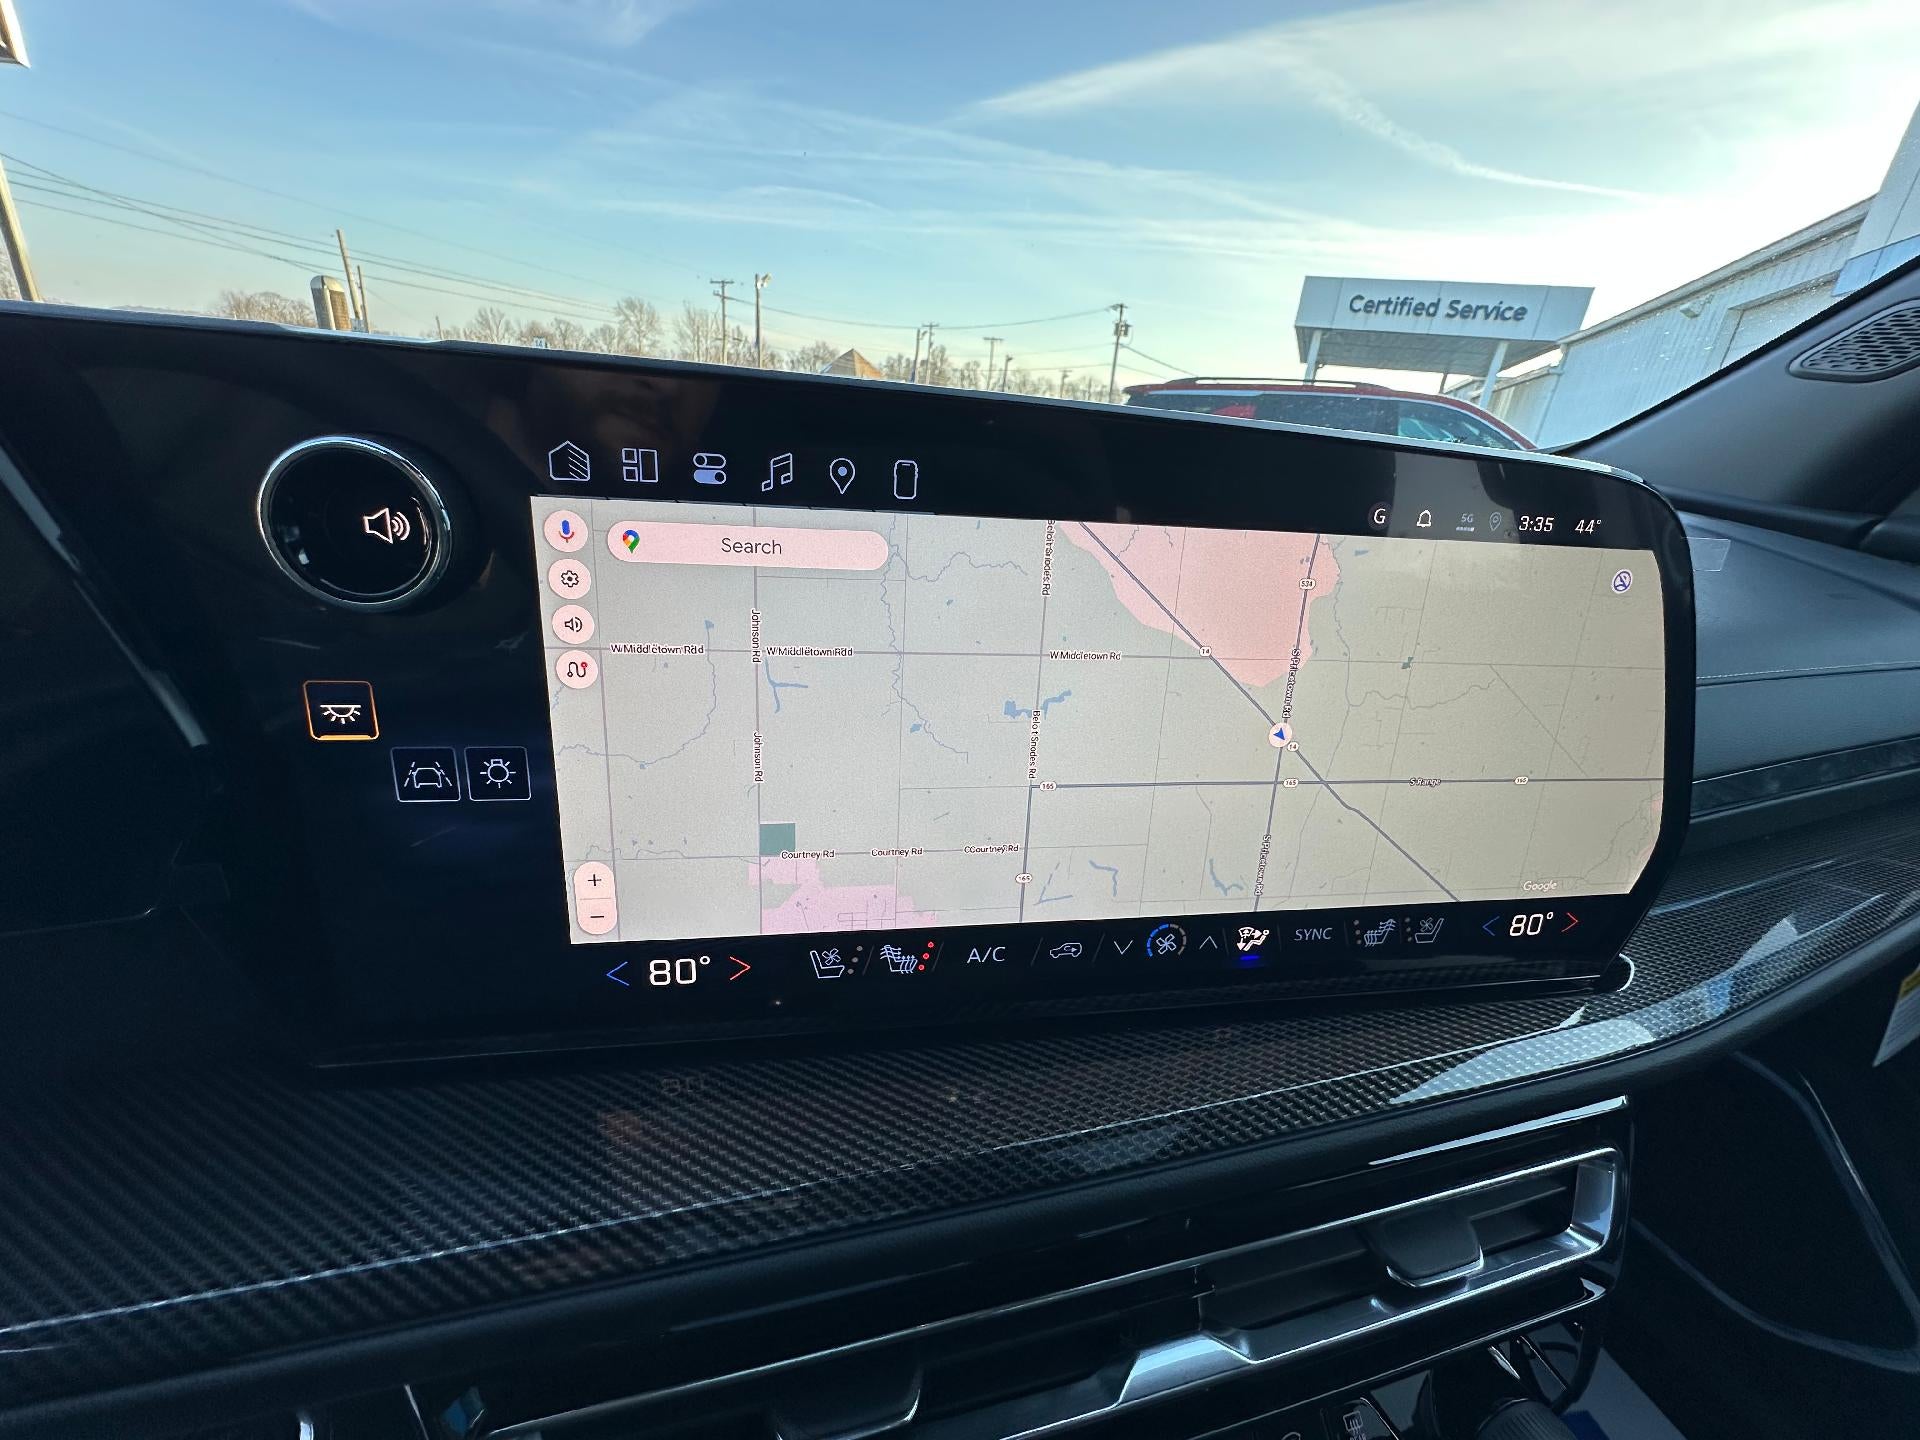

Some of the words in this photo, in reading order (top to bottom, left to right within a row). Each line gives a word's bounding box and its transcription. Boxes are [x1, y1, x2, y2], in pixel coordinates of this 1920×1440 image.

[1349, 294, 1440, 318] Certified
[1445, 299, 1528, 321] Service
[1460, 513, 1474, 524] 5G
[1518, 515, 1554, 532] 3:35
[1574, 519, 1602, 535] 44°
[721, 537, 782, 555] Search
[1041, 583, 1051, 596] Rd
[1301, 580, 1313, 588] 534
[751, 609, 761, 649] Johnson
[752, 650, 762, 663] Rd
[1050, 650, 1059, 660] W
[1110, 651, 1121, 660] Rd
[753, 732, 763, 769] Johnson
[1029, 736, 1039, 767] Snodes
[754, 770, 763, 782] Rd
[1028, 768, 1037, 779] Rd
[781, 851, 820, 861] Courtney
[823, 849, 835, 858] Rd
[871, 848, 909, 857] Courtney
[911, 847, 923, 855] Rd
[1008, 844, 1019, 852] Rd
[1523, 880, 1558, 892] Google
[1509, 911, 1554, 937] 80°
[1294, 927, 1333, 942] SYNC
[967, 946, 1006, 963] A/C
[648, 955, 711, 986] 80°
